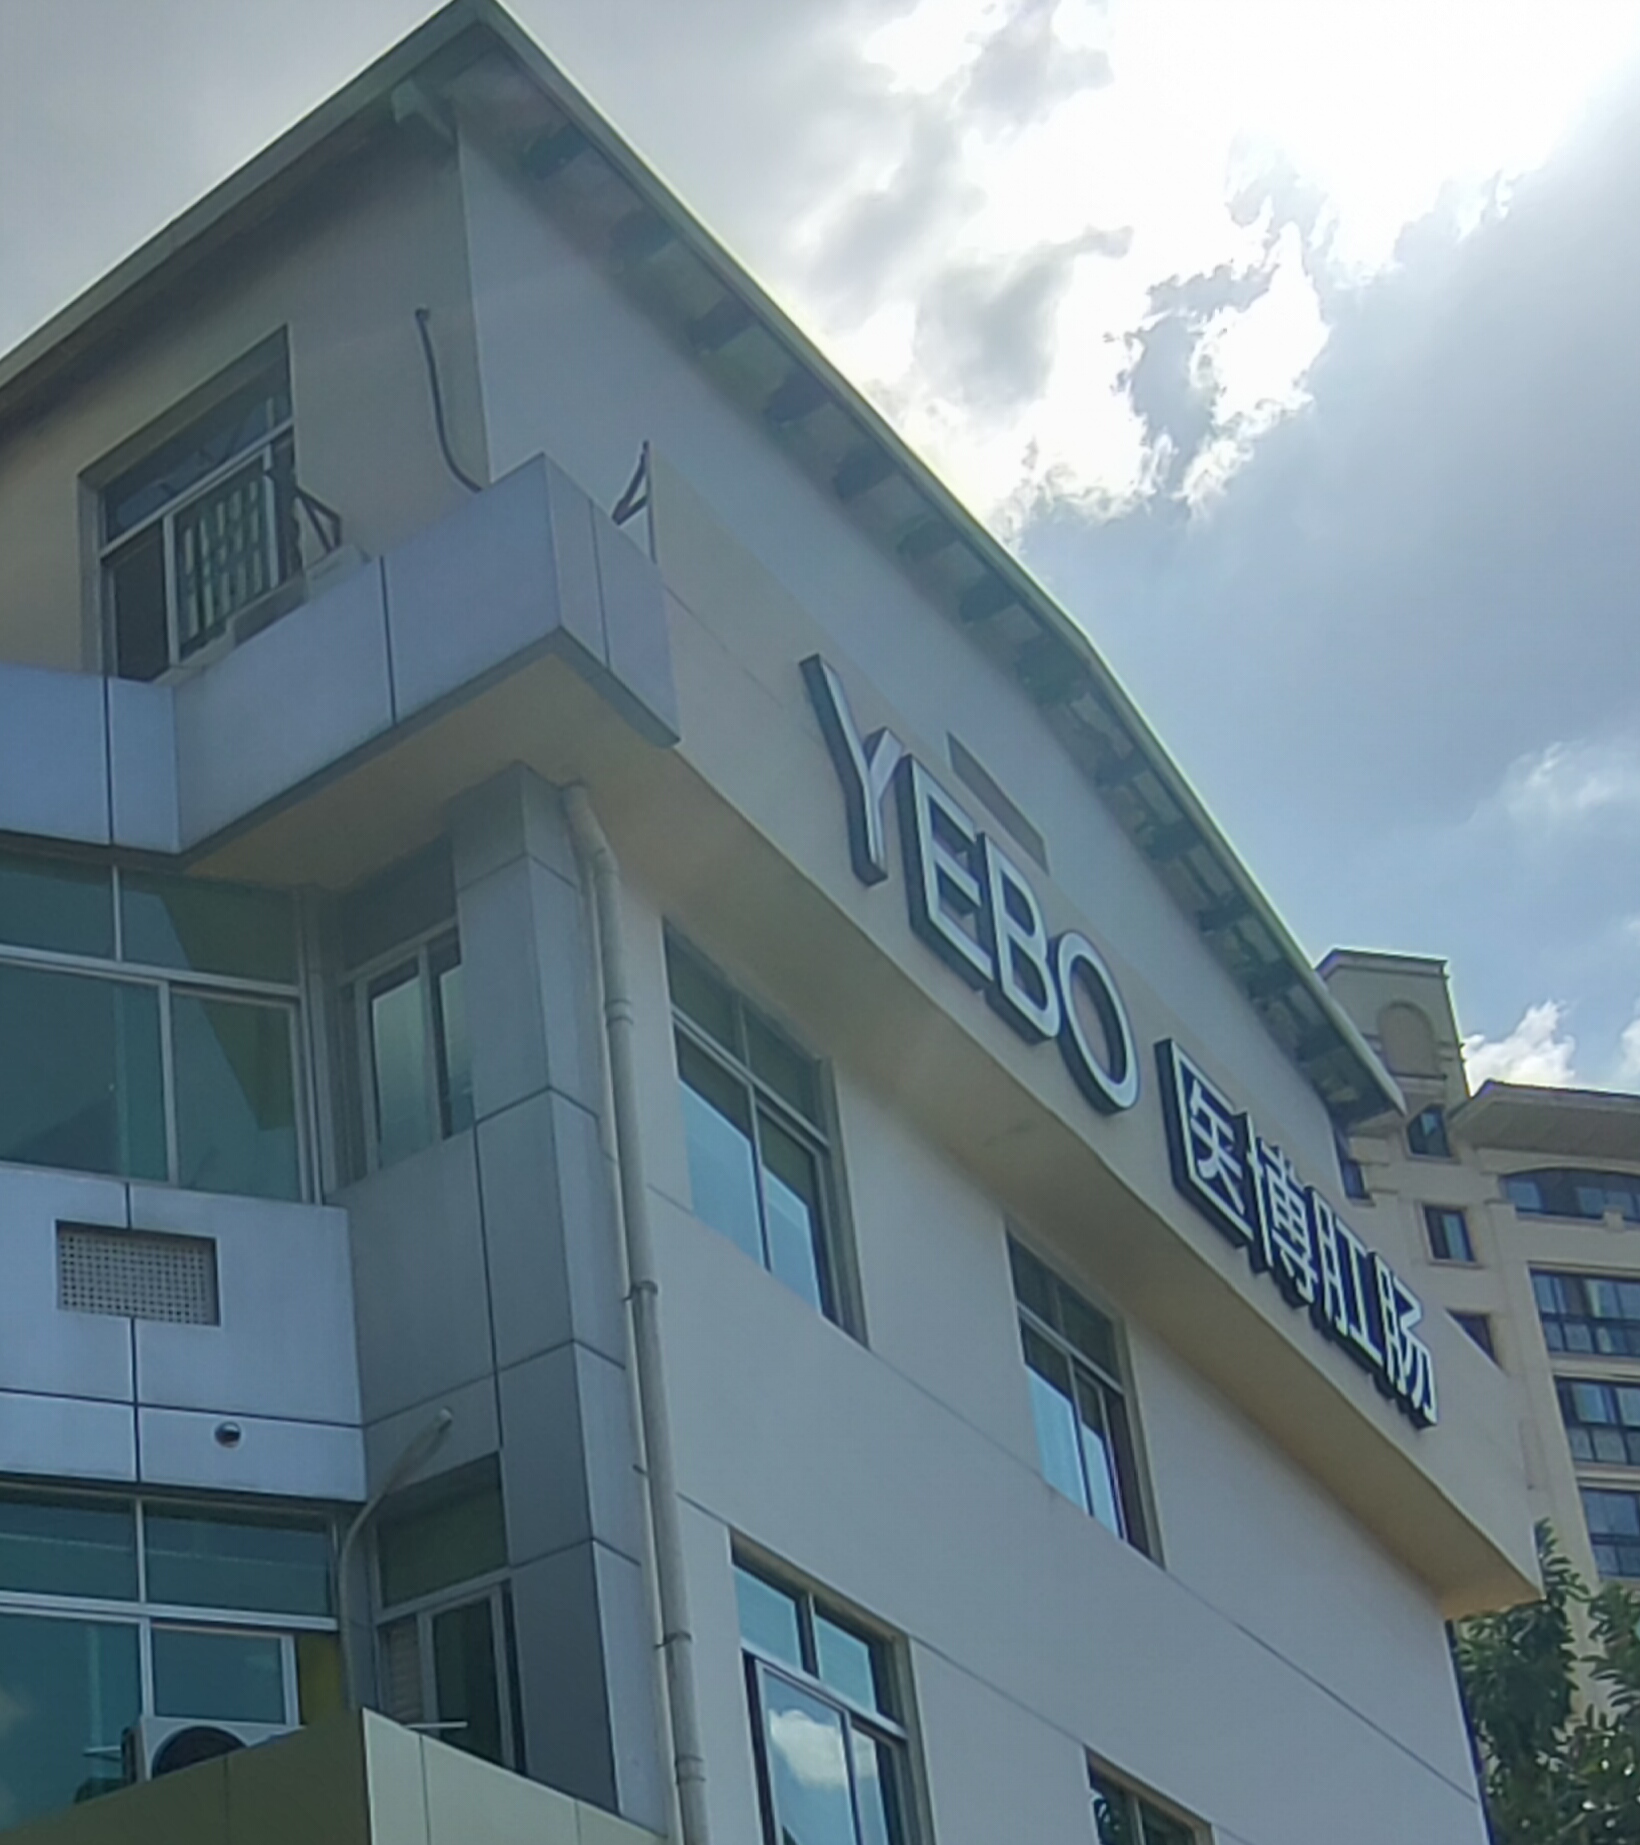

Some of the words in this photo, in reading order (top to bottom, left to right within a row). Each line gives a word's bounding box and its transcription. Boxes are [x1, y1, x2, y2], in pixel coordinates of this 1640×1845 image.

[799, 653, 1140, 1115] YEBO
[1154, 1038, 1439, 1428] 医博肛肠
